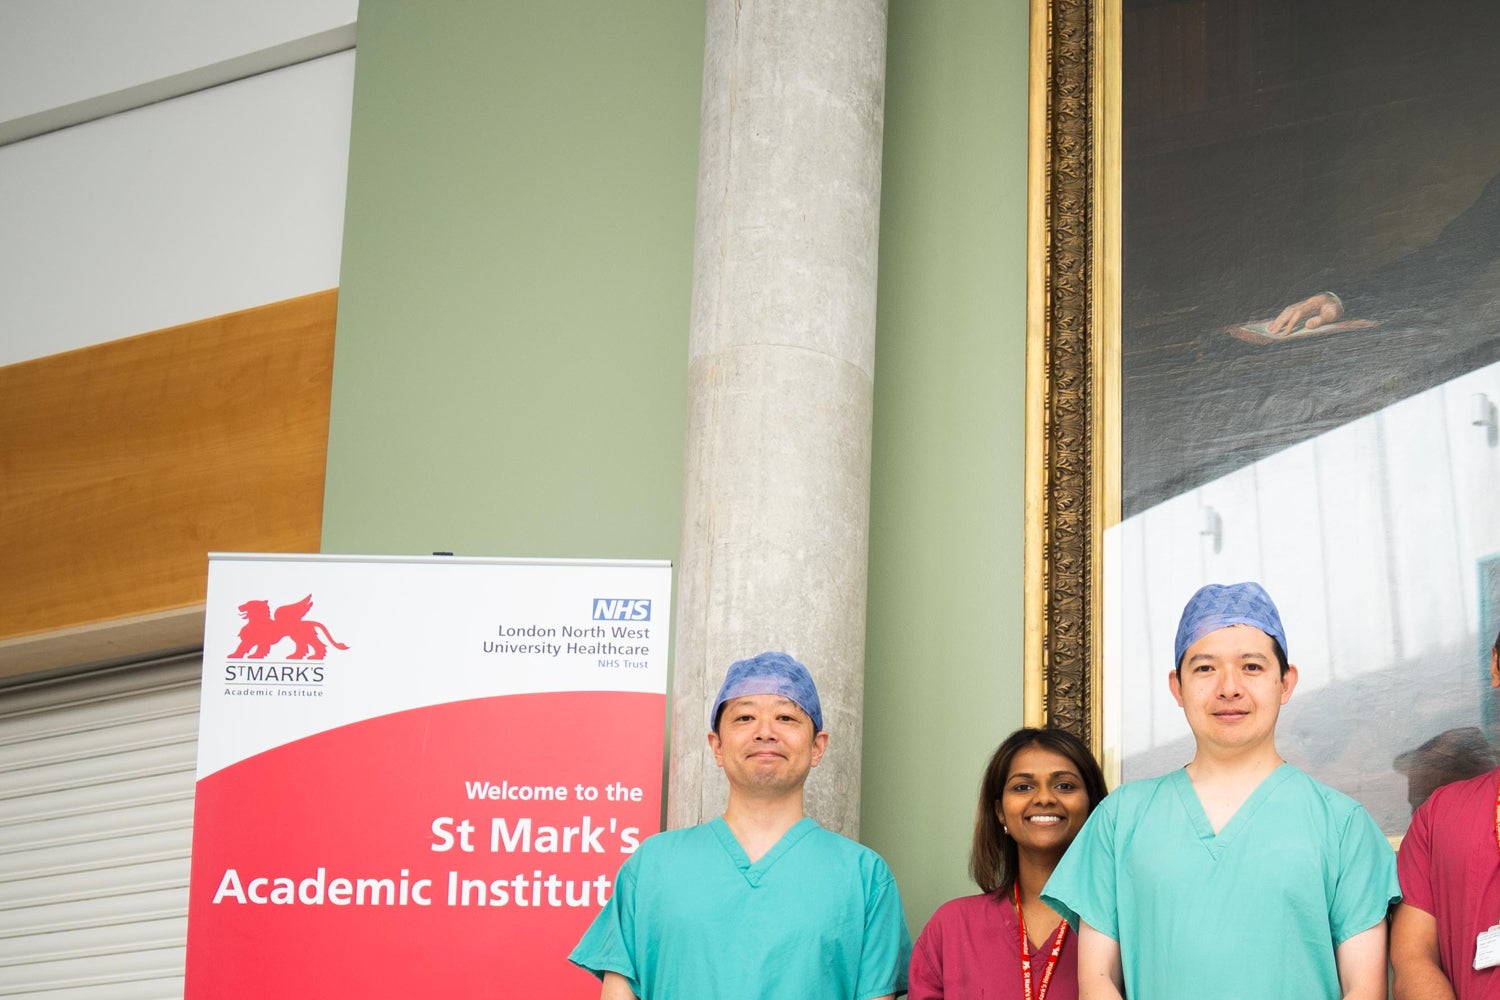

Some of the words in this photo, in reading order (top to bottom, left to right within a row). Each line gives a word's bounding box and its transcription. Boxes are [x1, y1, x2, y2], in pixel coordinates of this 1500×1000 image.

[594, 600, 649, 621] NHS
[498, 624, 557, 638] London
[561, 625, 607, 639] North
[611, 625, 650, 639] West
[483, 640, 562, 657] University
[567, 641, 650, 656] Healthcare
[598, 659, 620, 669] NHS
[623, 659, 649, 669] Trust
[224, 688, 274, 697] Academic
[277, 688, 324, 698] Institute
[465, 781, 567, 801] Welcome
[575, 783, 598, 801] to
[605, 782, 643, 802] the
[430, 817, 474, 853] St
[490, 816, 640, 854] Mark's
[212, 866, 432, 906] Academic
[447, 870, 611, 907] Institut
